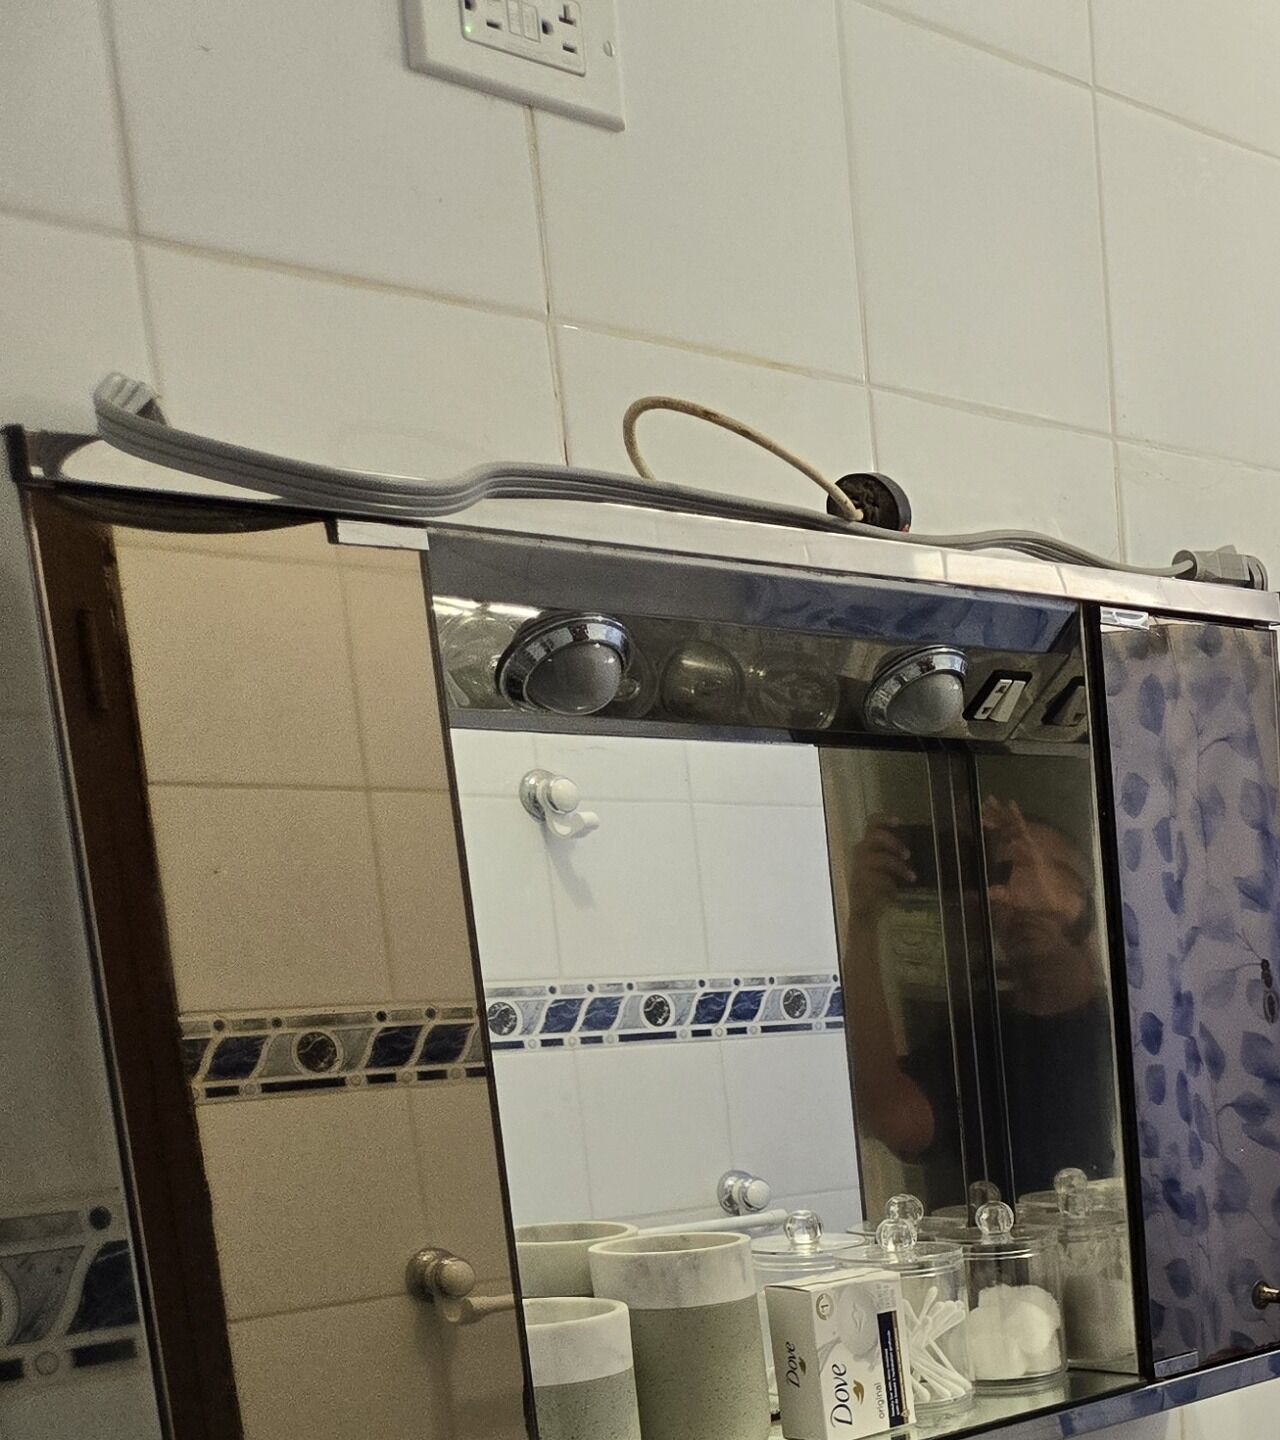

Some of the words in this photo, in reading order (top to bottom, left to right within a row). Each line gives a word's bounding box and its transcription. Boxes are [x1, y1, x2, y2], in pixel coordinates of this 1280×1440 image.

[784, 1341, 801, 1389] Dove
[830, 1363, 853, 1428] Dove
[873, 1382, 885, 1420] original
